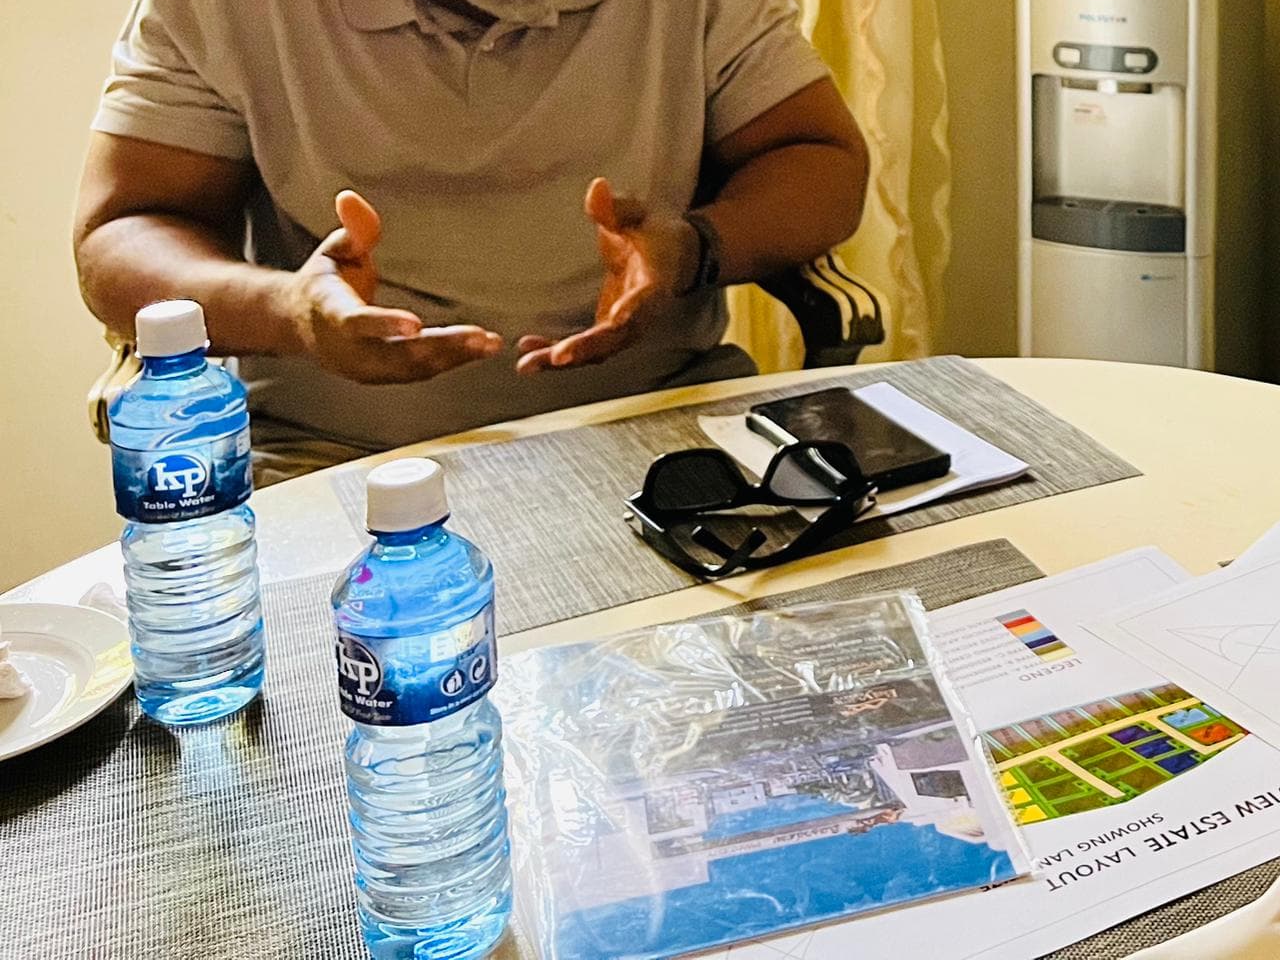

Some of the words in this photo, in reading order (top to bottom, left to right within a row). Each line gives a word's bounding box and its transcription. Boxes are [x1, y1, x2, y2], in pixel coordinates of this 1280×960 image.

[143, 500, 177, 510] Table
[178, 494, 216, 507] Water
[1018, 658, 1083, 682] LEGEND
[354, 695, 394, 709] Water
[1077, 812, 1164, 852] SHOWING
[1143, 809, 1232, 853] ESTATE
[1040, 846, 1075, 867] LAN
[1046, 845, 1137, 892] LAYOUT
